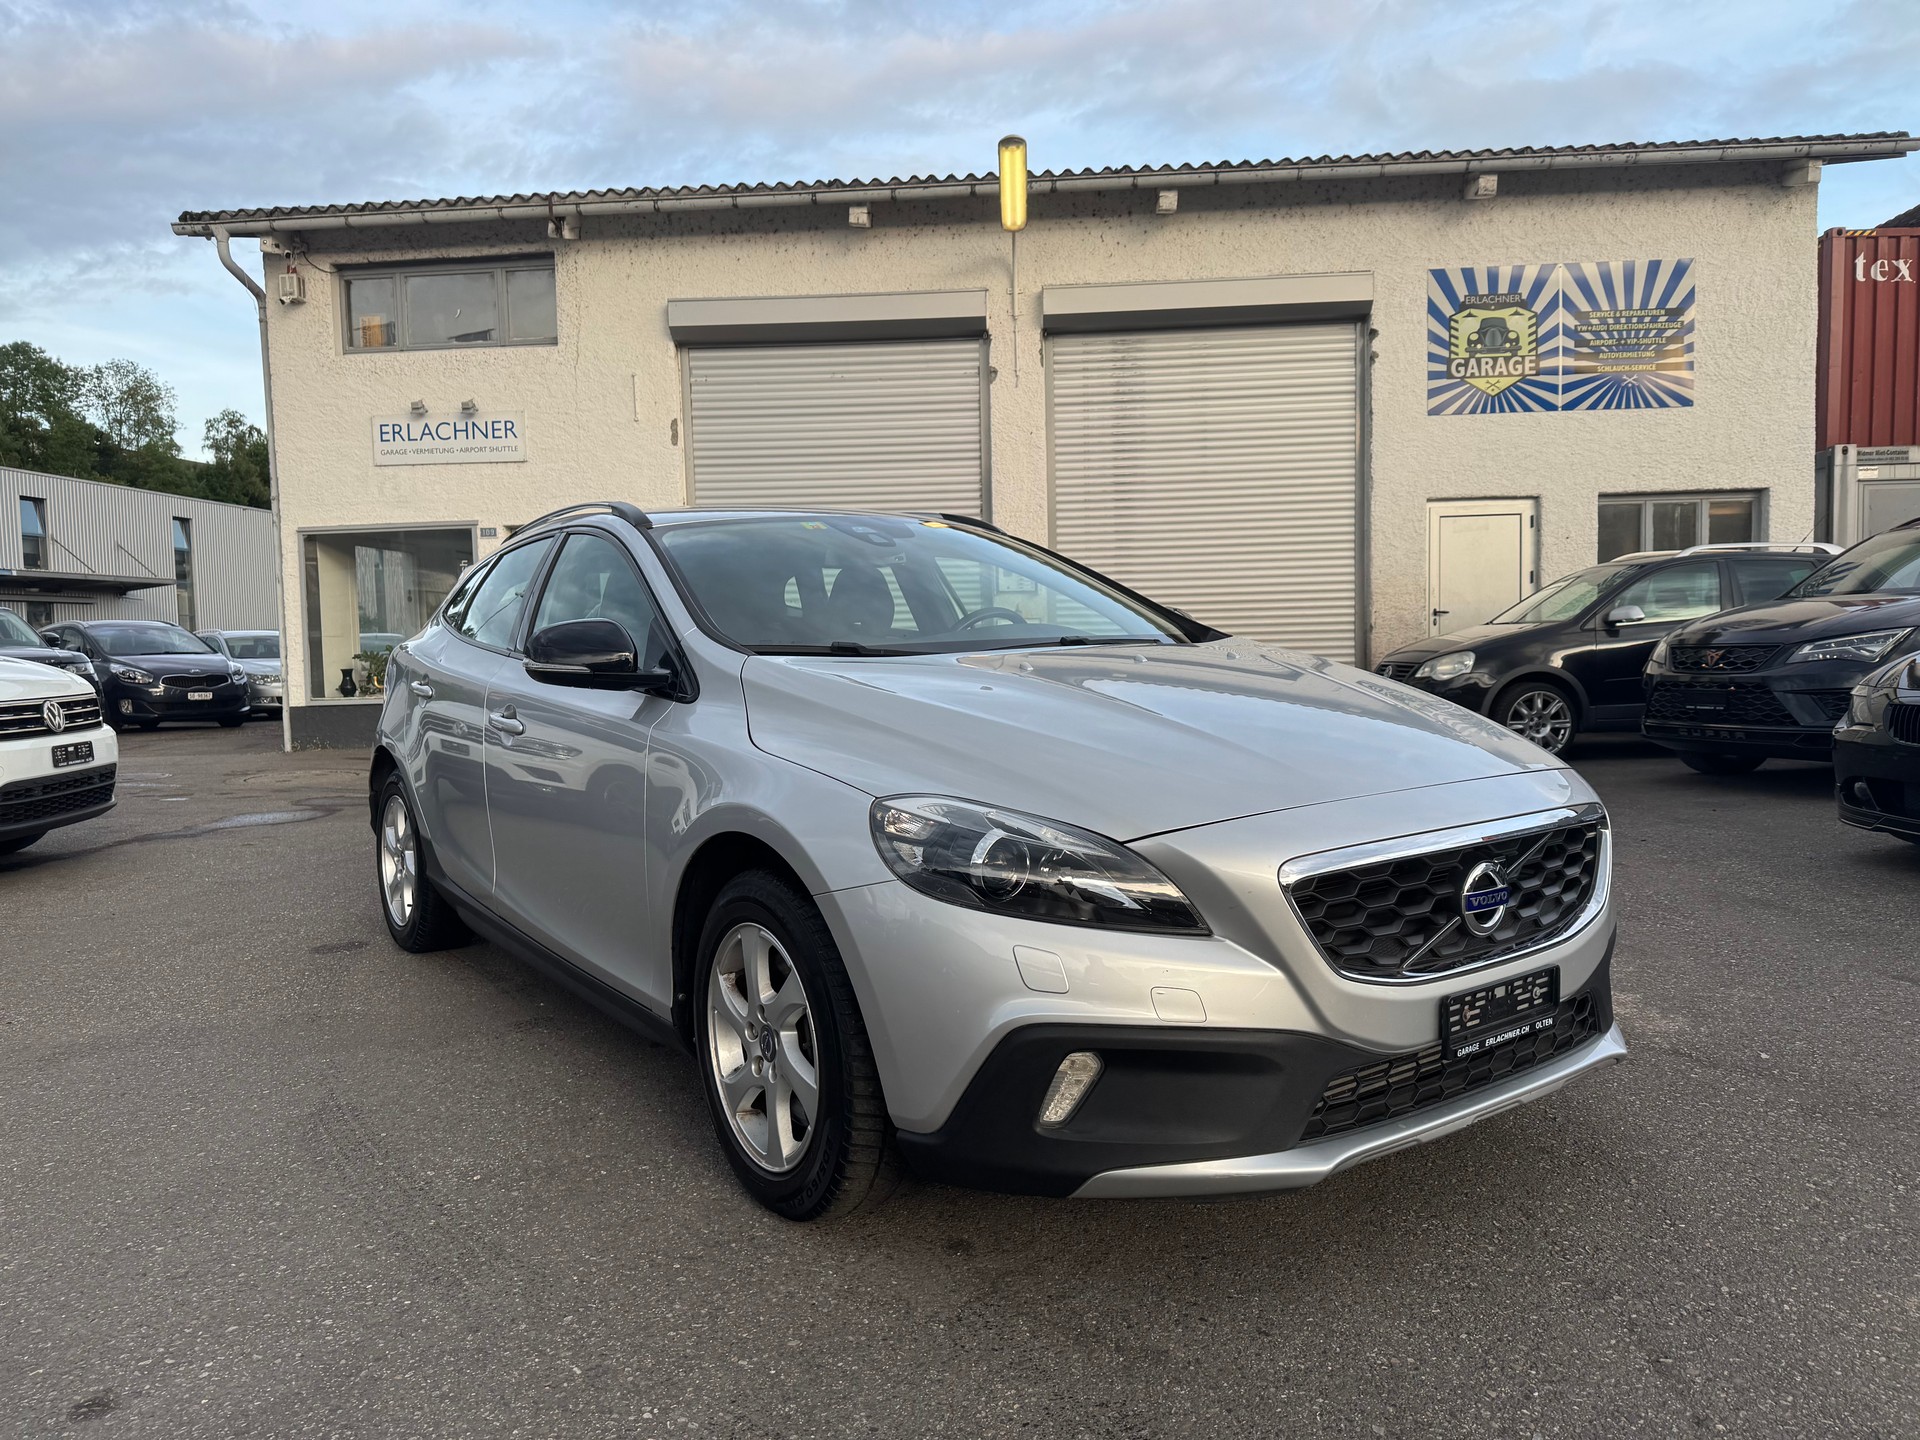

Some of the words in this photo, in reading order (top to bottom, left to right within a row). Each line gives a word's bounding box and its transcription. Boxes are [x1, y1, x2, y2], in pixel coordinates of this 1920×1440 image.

[1465, 294, 1521, 305] ERLACHNER
[1589, 311, 1615, 319] SERVICE
[1622, 309, 1666, 317] REPARATUREN
[1609, 322, 1682, 331] DIREKTIONSFAHRZEUGE
[1590, 338, 1619, 346] AIRPORT-
[1627, 337, 1667, 345] VIP-SHUTTLE
[1599, 351, 1656, 359] AUTOVERMIETUNG
[1450, 356, 1537, 377] GARAGE
[1597, 364, 1657, 372] SCHLAUCH-SERVICE
[379, 420, 518, 442] ERLACHNER
[380, 448, 408, 456] GARAGE
[411, 447, 455, 455] VERMIETUNG
[459, 446, 488, 454] AIRPORT
[489, 445, 519, 453] SHUTTLE
[1470, 891, 1508, 907] VOLVO
[1457, 1042, 1480, 1057] GARAGE
[1485, 1025, 1530, 1047] ERLACHNER.CH
[1535, 1017, 1553, 1030] OLTEN
